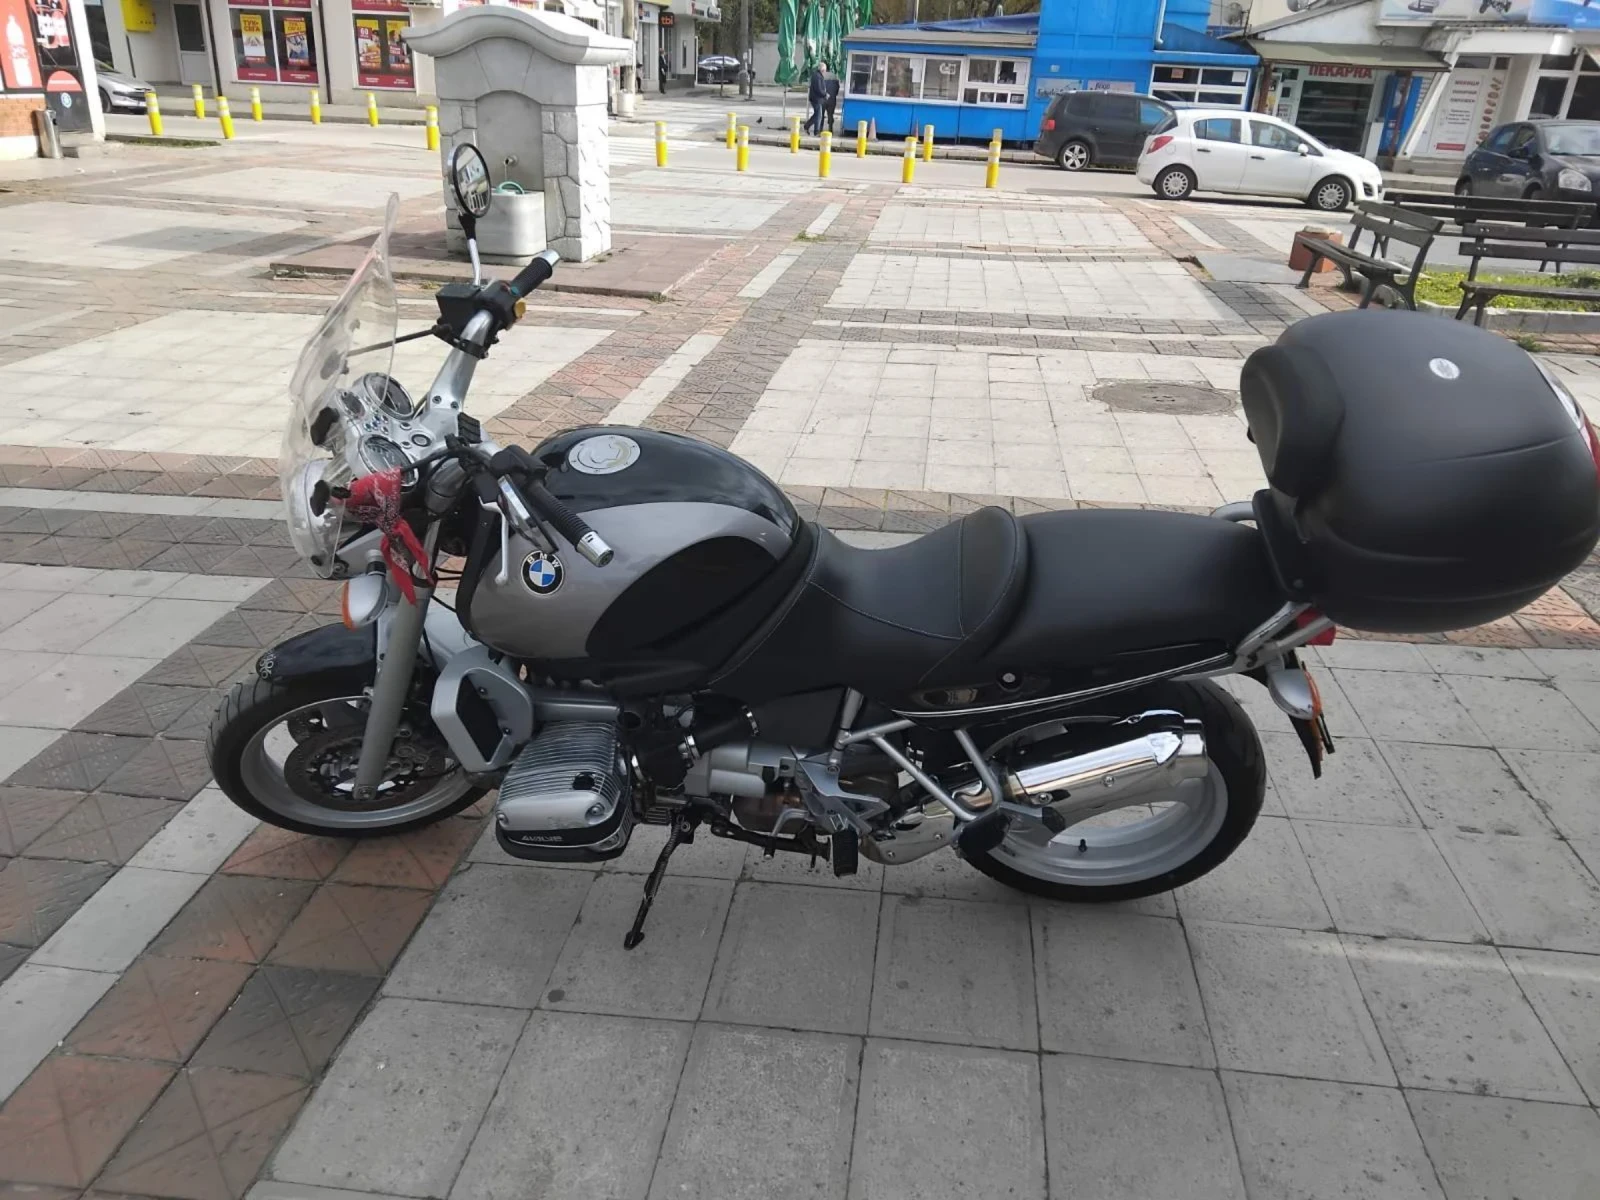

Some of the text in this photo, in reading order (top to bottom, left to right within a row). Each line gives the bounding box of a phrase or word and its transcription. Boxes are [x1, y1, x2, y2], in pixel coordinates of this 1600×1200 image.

[661, 15, 673, 25] tbi
[1308, 64, 1372, 79] ПЕКАРНА
[527, 552, 561, 568] BMW
